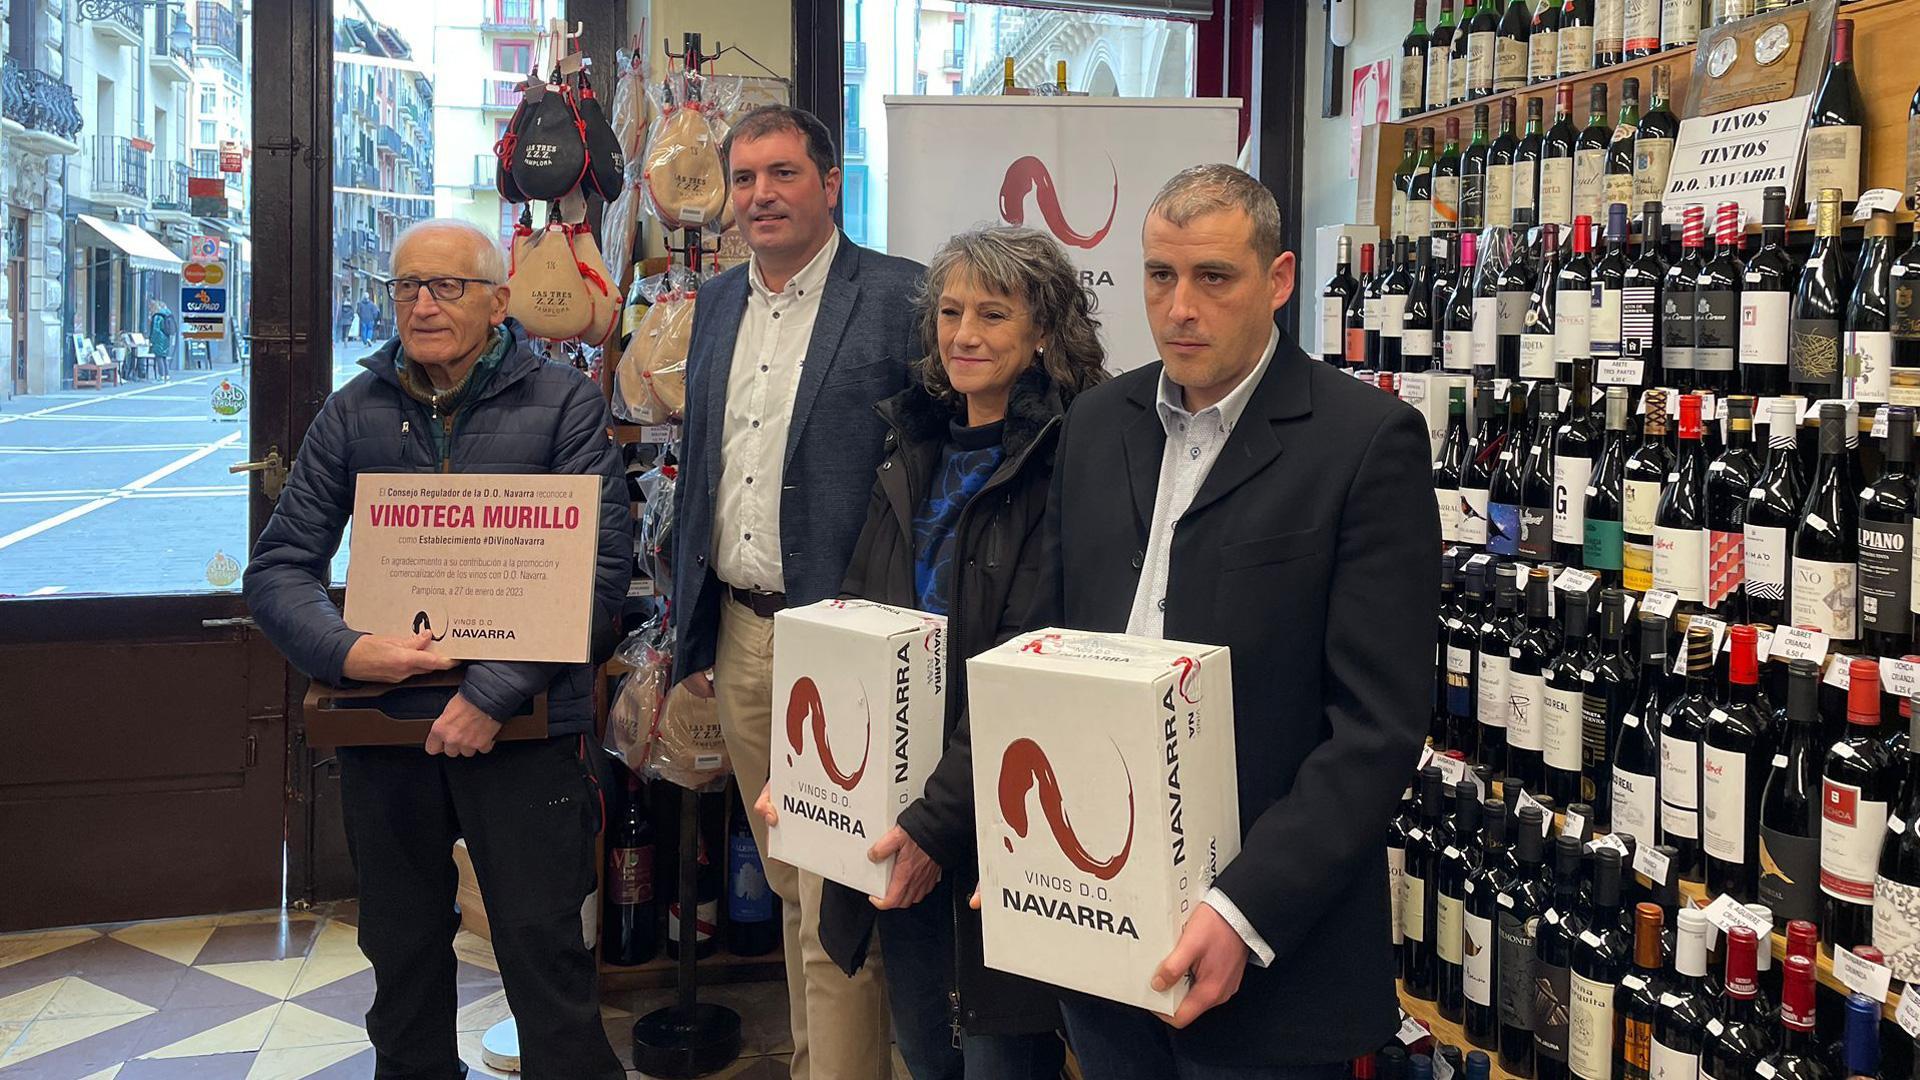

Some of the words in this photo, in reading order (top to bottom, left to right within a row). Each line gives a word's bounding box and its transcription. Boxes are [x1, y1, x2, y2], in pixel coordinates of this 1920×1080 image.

[1711, 110, 1769, 135] VINOS
[537, 144, 557, 152] TRES
[1700, 140, 1769, 165] TINTOS
[1670, 177, 1700, 193] D.O.
[1708, 166, 1786, 190] NAVARRA
[1080, 270, 1115, 287] RA
[531, 290, 548, 299] LAS
[550, 290, 573, 299] TRES
[533, 304, 571, 315] PAMPLONA
[1616, 368, 1636, 376] PARTES
[379, 489, 387, 497] El
[387, 488, 418, 499] Consejo
[420, 488, 459, 500] Regulador
[461, 488, 471, 498] de
[473, 488, 481, 498] la
[484, 489, 501, 498] D.O.
[504, 489, 534, 500] Navarra
[536, 491, 568, 500] reconoce
[369, 504, 475, 528] VINOTECA
[483, 505, 579, 530] MURILLO
[398, 537, 418, 545] como
[418, 536, 480, 547] Establecimiento
[483, 536, 545, 547] #DiVinoNavarra
[1862, 529, 1905, 551] PIANO
[380, 556, 390, 566] En
[391, 557, 442, 568] agradecimiento
[450, 559, 458, 569] su
[459, 558, 501, 569] contribución
[509, 559, 515, 568] la
[516, 560, 553, 571] promoción
[554, 561, 560, 571] y
[389, 568, 445, 579] comercialización
[446, 570, 455, 579] de
[457, 570, 467, 580] los
[469, 571, 487, 580] vinos
[489, 572, 501, 580] con
[411, 585, 447, 597] Pamplona,
[454, 586, 464, 596] 27
[465, 587, 474, 597] de
[475, 588, 494, 598] enero
[496, 588, 505, 598] de
[506, 588, 524, 599] 2023
[453, 618, 477, 627] VINOS
[1704, 620, 1719, 628] REAL
[452, 627, 516, 641] NAVARRA
[1759, 631, 1770, 640] SUS
[1789, 630, 1812, 639] ALBRET
[1784, 638, 1812, 651] CRIANZA
[934, 628, 943, 695] NAVARRA
[1799, 651, 1805, 660] €
[1894, 662, 1914, 672] OCHOA
[1891, 673, 1915, 684] CRIANZA
[1907, 687, 1913, 695] €
[895, 641, 912, 785] NAVARRA
[1552, 699, 1569, 713] REAL
[1163, 684, 1186, 866] NAVARRA
[1618, 776, 1634, 793] REAL
[798, 782, 828, 801] VINOS
[830, 794, 852, 809] D.O.
[783, 794, 867, 839] NAVARRA
[1024, 870, 1072, 893] VINOS
[1079, 881, 1113, 903] D.O.
[1002, 887, 1140, 941] NAVARRA
